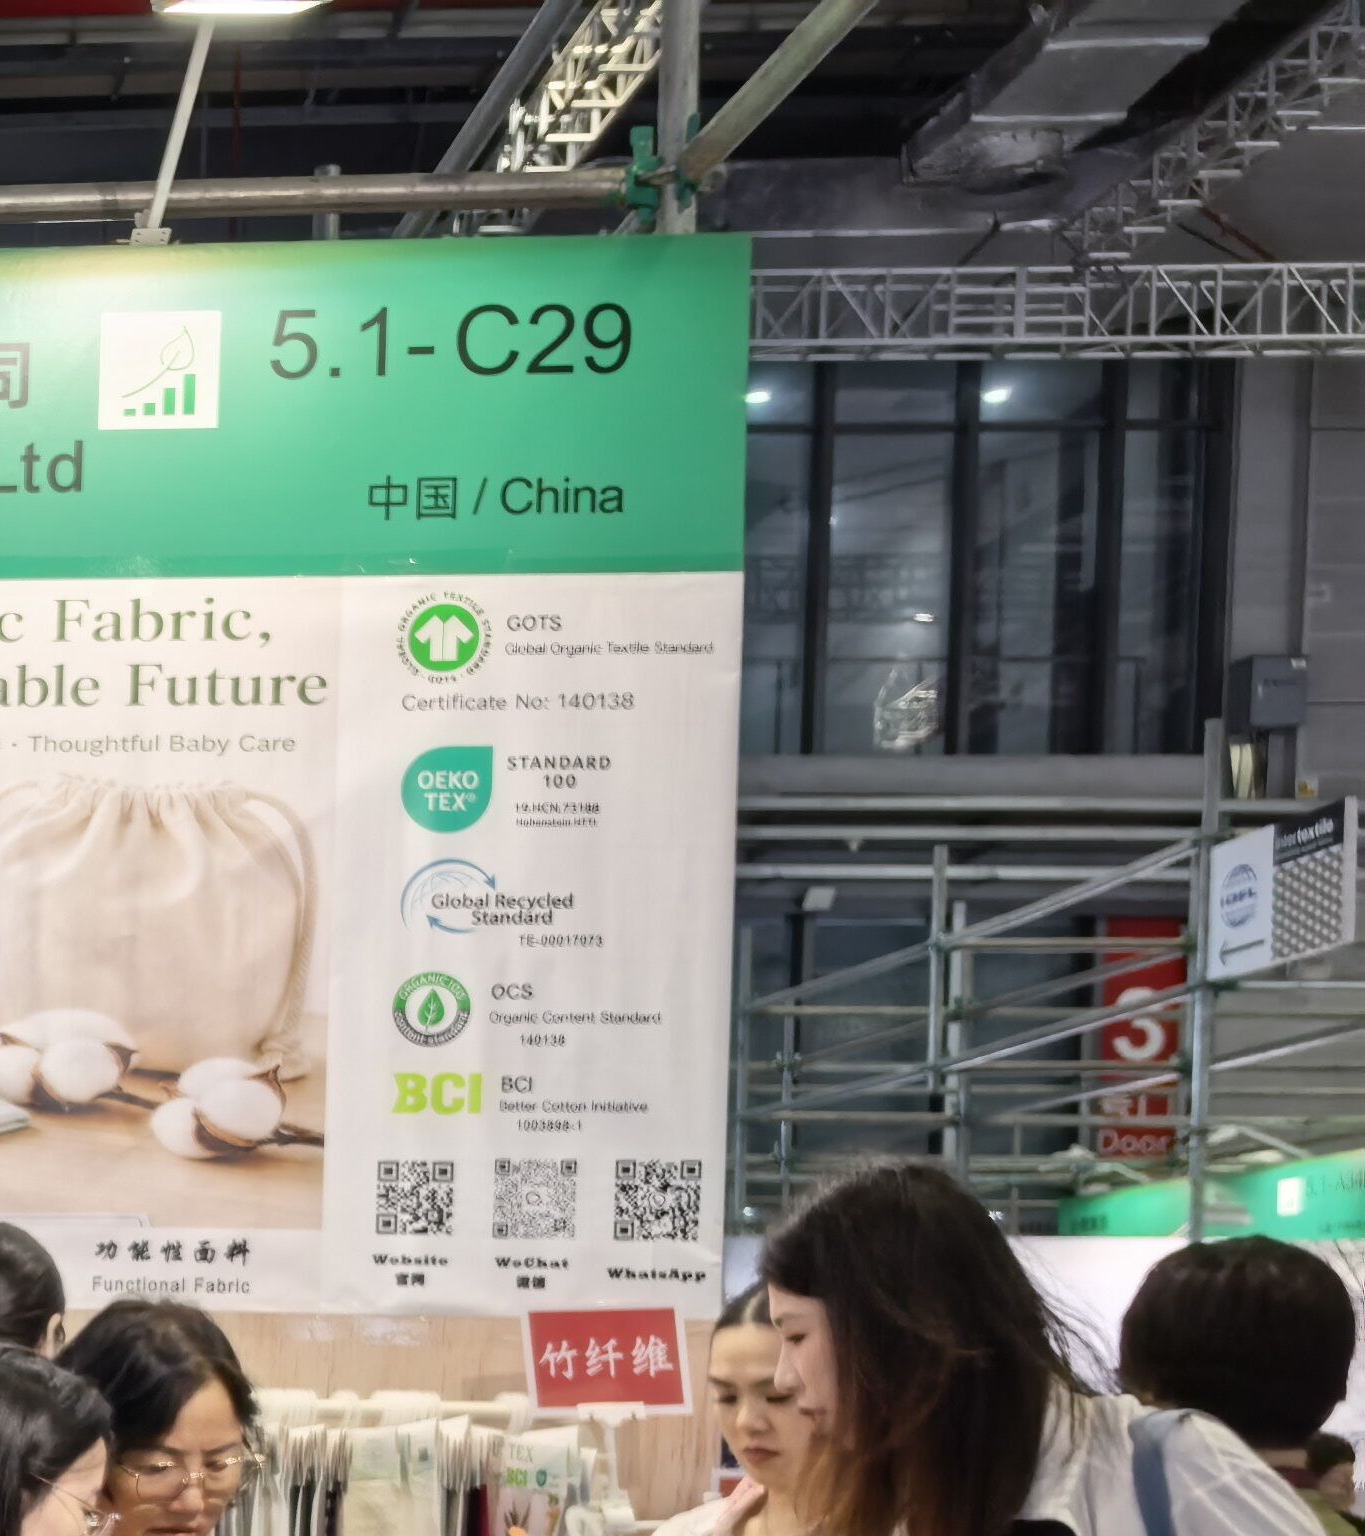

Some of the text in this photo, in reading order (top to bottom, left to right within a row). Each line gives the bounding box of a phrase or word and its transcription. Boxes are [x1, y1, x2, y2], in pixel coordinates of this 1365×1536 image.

[269, 301, 635, 381] 5.1-C29
[367, 473, 459, 523] 中国
[499, 473, 626, 517] China
[52, 597, 273, 648] Fabric,
[506, 614, 563, 633] GOTS
[504, 640, 715, 658] Global Organic Textile Standard
[126, 662, 329, 708] Future
[401, 691, 636, 712] Certificate No: 140138
[28, 734, 160, 758] Thoughtful
[169, 733, 229, 757] Baby
[238, 734, 297, 754] Care
[506, 755, 612, 772] STANDARD
[417, 770, 480, 790] OEKO
[542, 774, 577, 790] 100
[430, 892, 575, 911] Global Recycled
[471, 910, 554, 927] Standard
[491, 983, 534, 1001] OCS
[488, 1010, 663, 1026] Organic Content Standard
[392, 1072, 484, 1116] BCI
[500, 1075, 534, 1094] BCI
[499, 1099, 649, 1113] Better Cotton Initiative
[94, 1237, 252, 1266] 功能性面料
[372, 1253, 450, 1267] Website
[495, 1255, 570, 1270] WeChat
[606, 1266, 707, 1283] WhatsApp
[91, 1275, 252, 1295] Functional Fabric
[539, 1334, 675, 1381] 竹纤维
